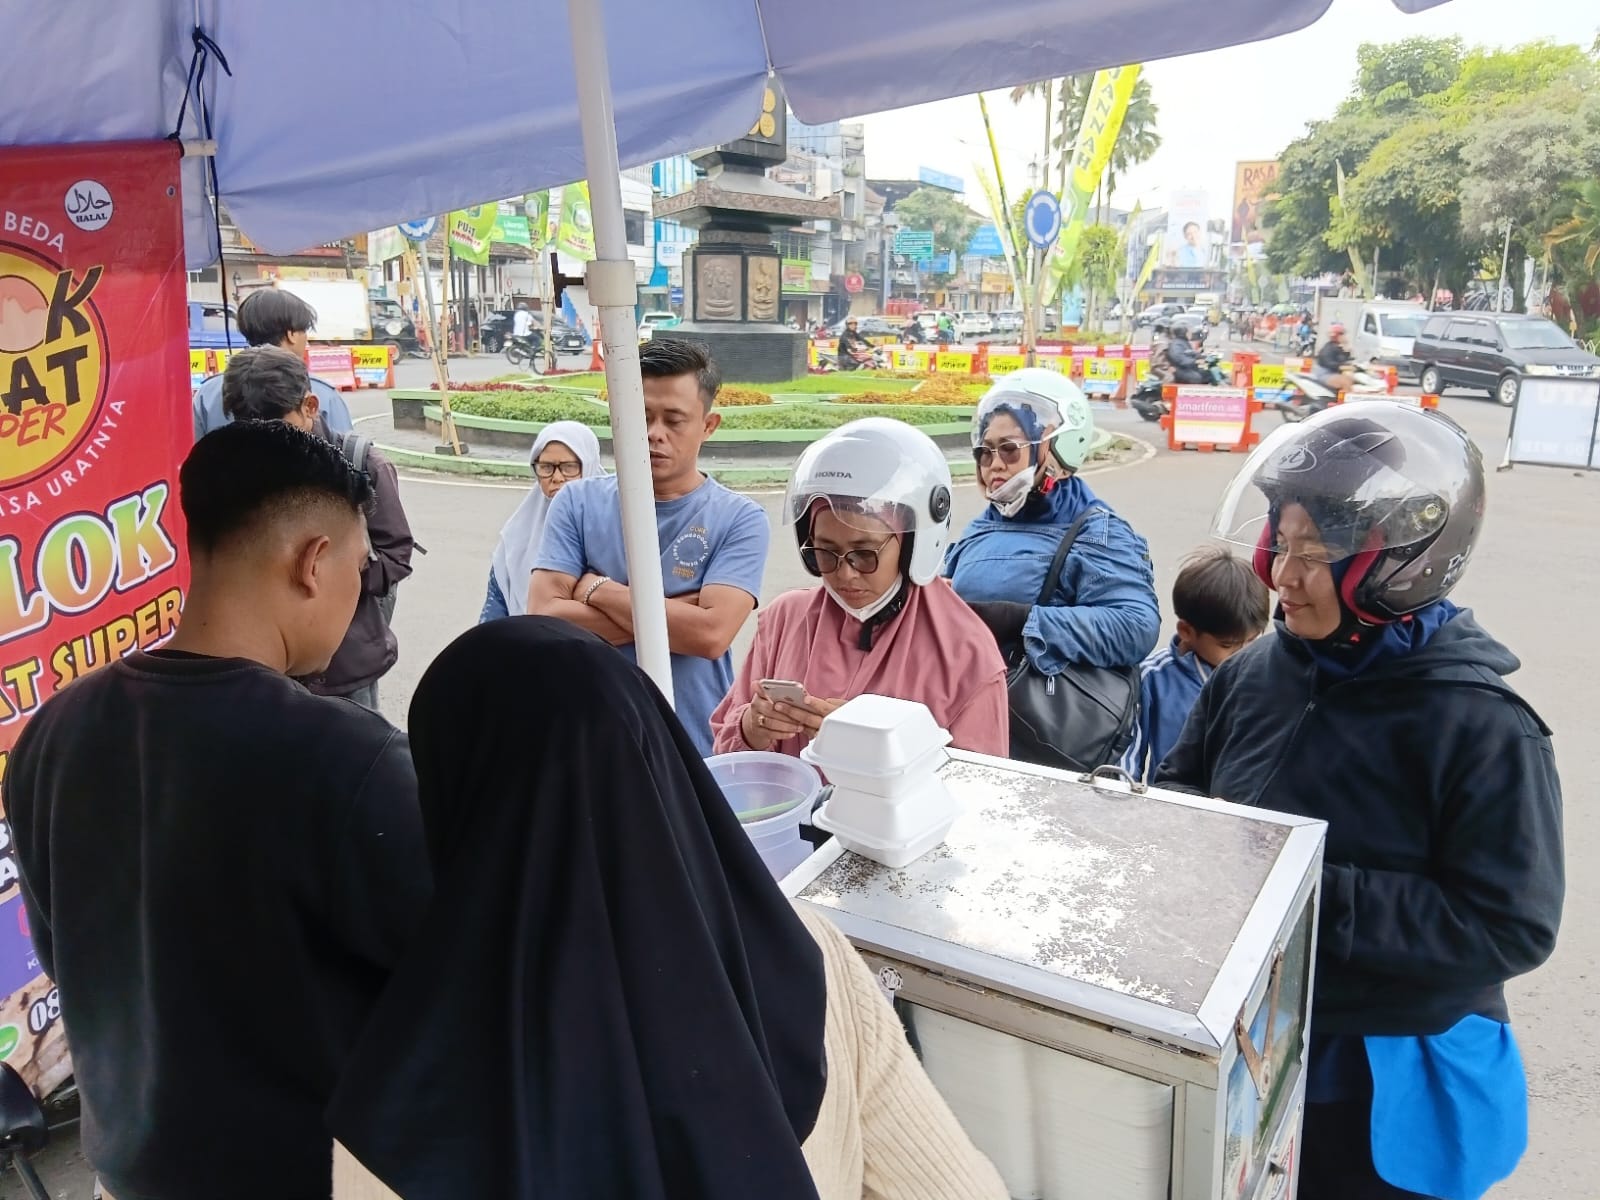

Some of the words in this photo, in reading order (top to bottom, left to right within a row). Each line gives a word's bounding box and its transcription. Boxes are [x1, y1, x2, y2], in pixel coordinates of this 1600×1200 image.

[66, 188, 111, 214] حلال
[76, 212, 108, 223] HALAL
[4, 210, 65, 253] BEDA
[361, 356, 383, 366] WER
[46, 399, 127, 497] URATNYA
[815, 471, 853, 480] HONDA
[50, 586, 184, 692] SUPER
